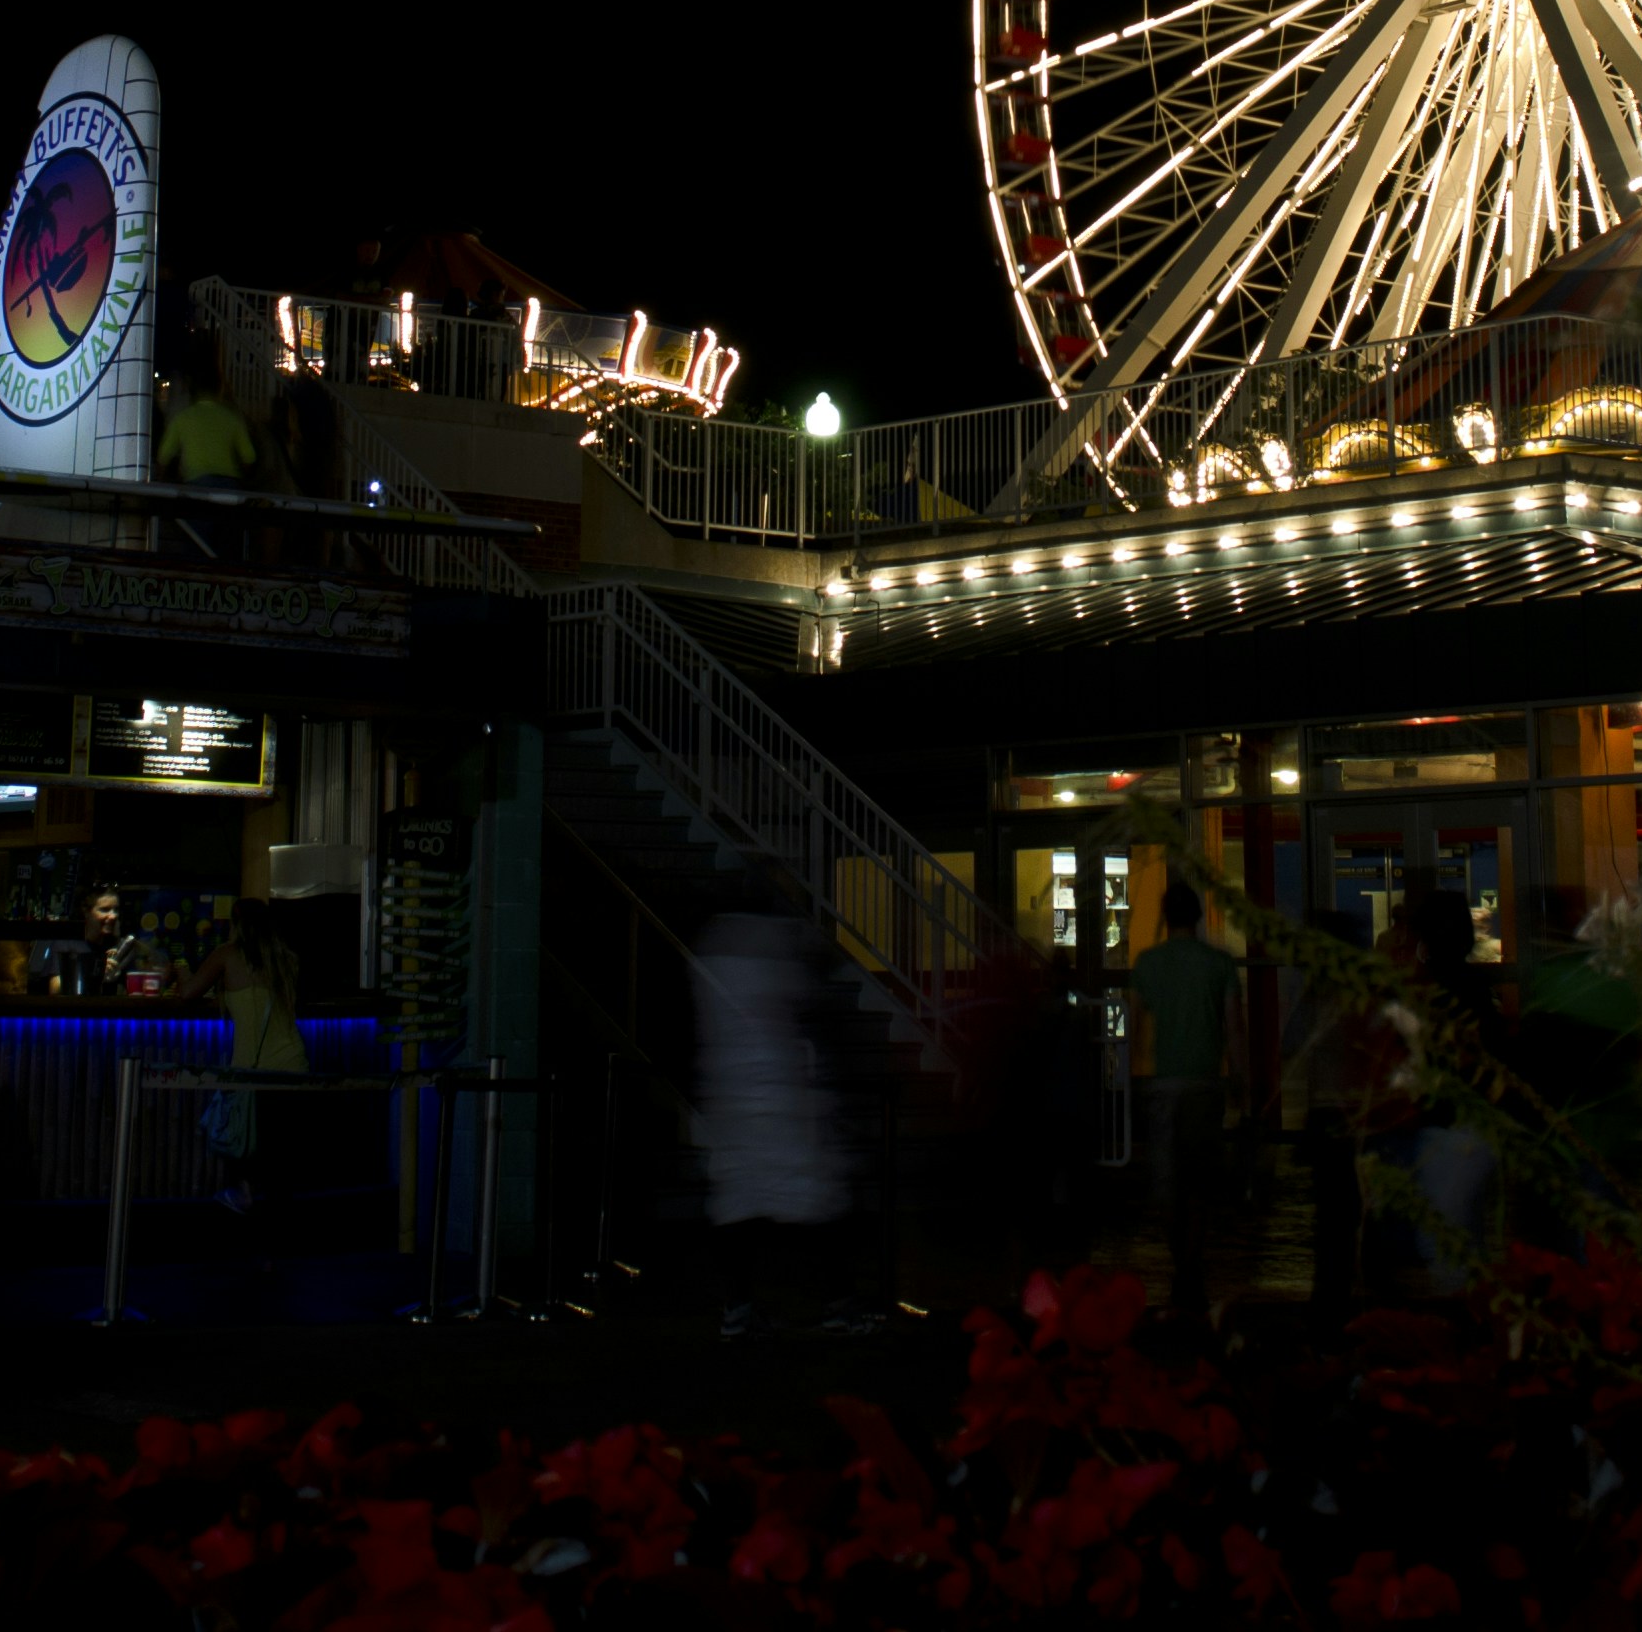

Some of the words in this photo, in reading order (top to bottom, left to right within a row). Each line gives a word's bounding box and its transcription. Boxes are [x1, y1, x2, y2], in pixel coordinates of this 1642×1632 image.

[34, 106, 136, 187] BUFFETT'S
[80, 567, 239, 615] MARGARITAS
[243, 595, 260, 614] to
[266, 586, 310, 625] GO
[399, 816, 453, 835] DRINKS
[403, 837, 416, 851] to
[419, 836, 445, 856] GO
